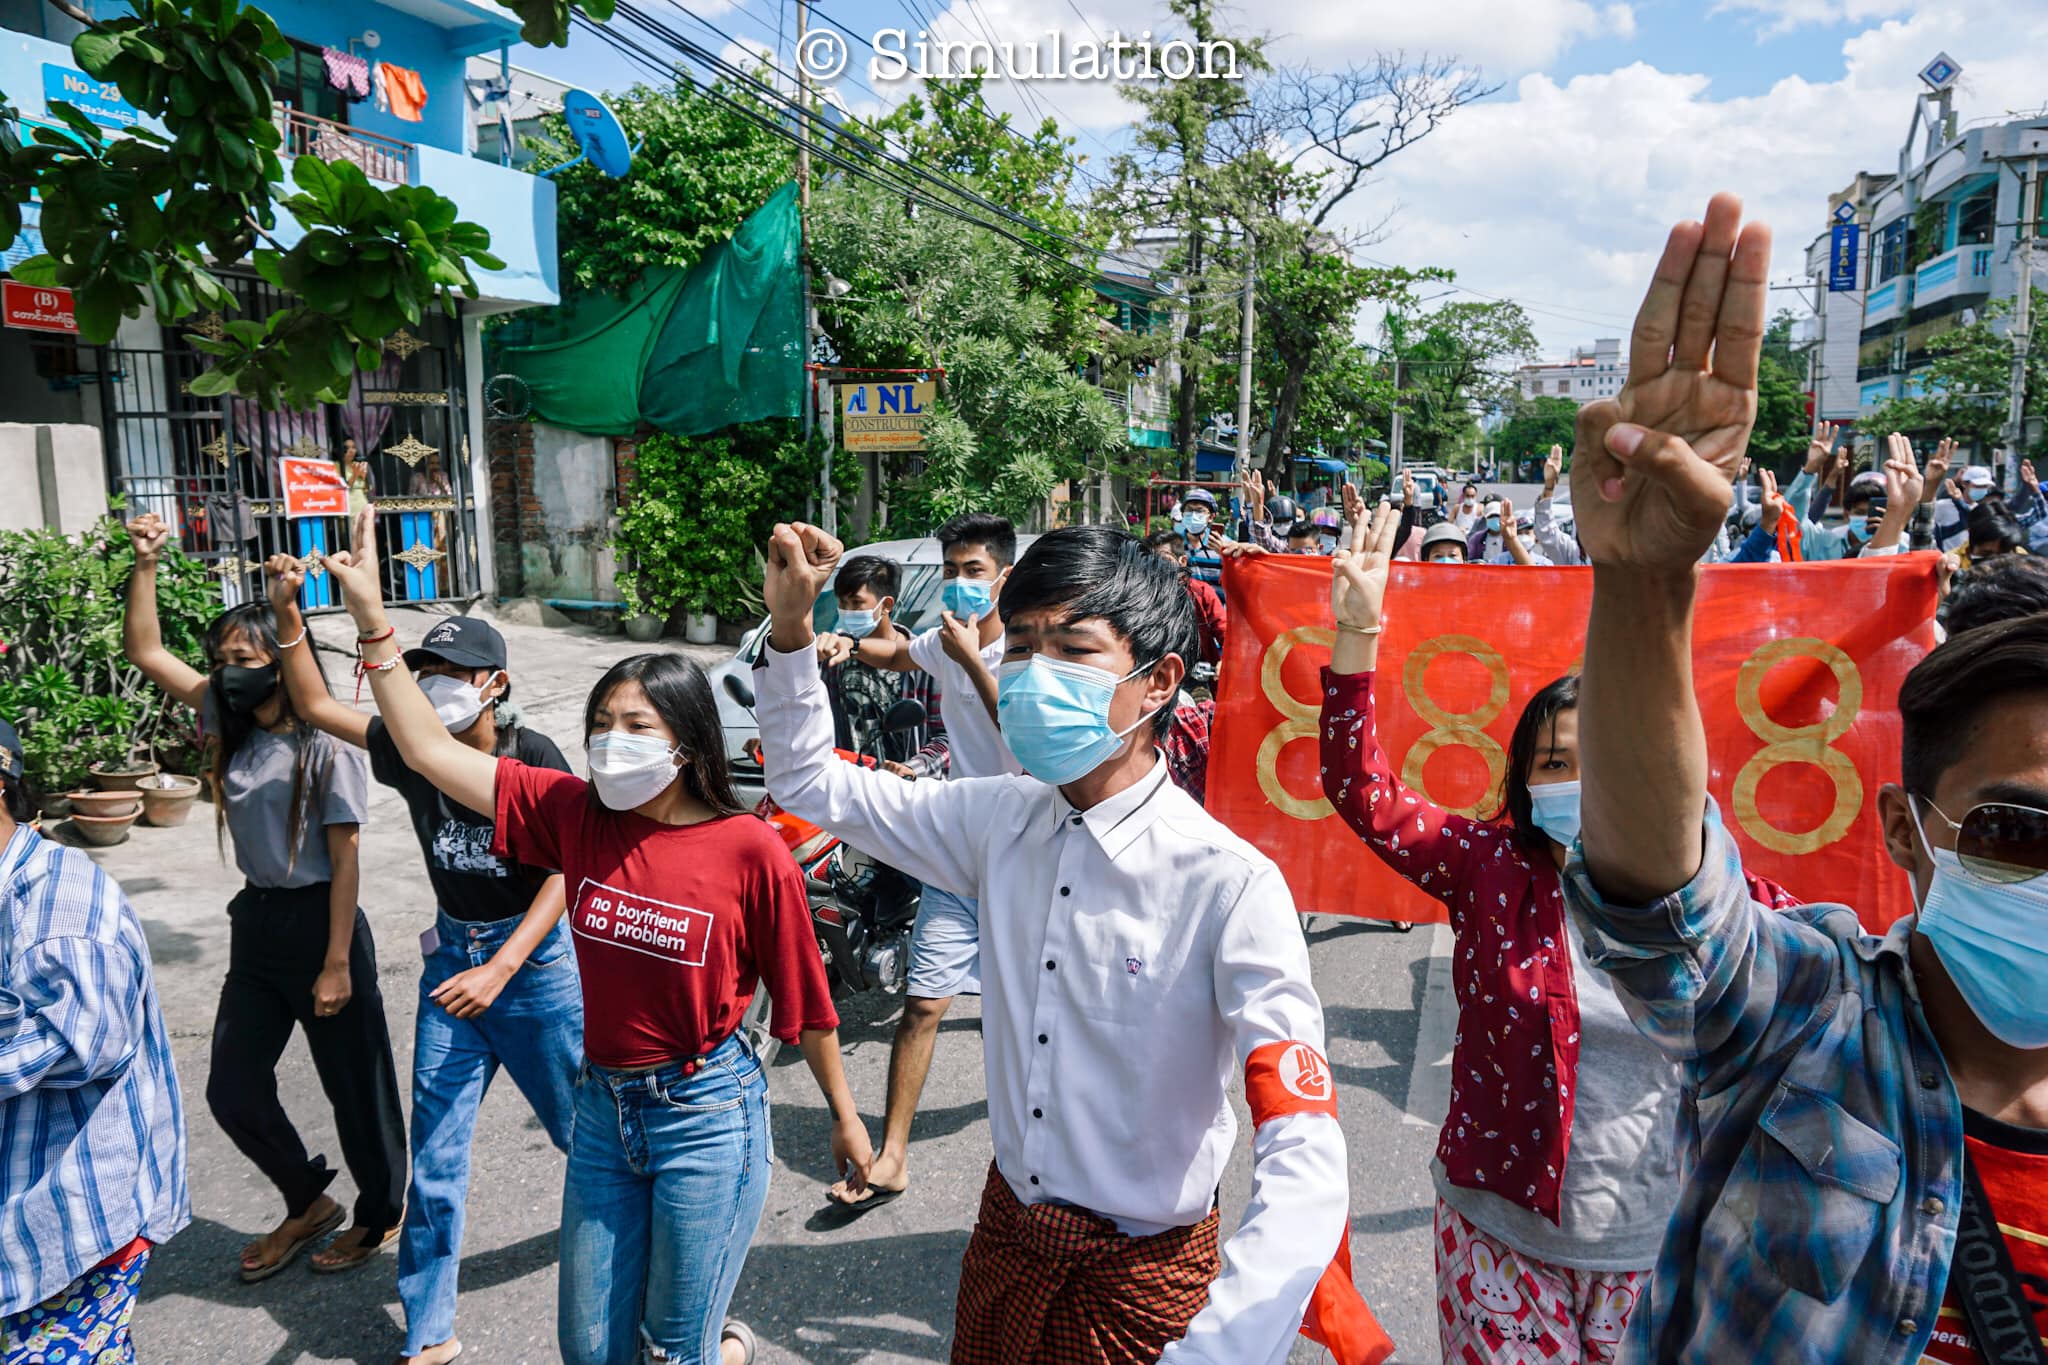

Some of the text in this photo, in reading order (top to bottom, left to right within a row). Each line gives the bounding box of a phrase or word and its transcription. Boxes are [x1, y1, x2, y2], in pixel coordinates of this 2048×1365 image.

[876, 384, 922, 414] NL
[585, 912, 686, 951] no problem
[591, 896, 690, 933] no boyfriend
